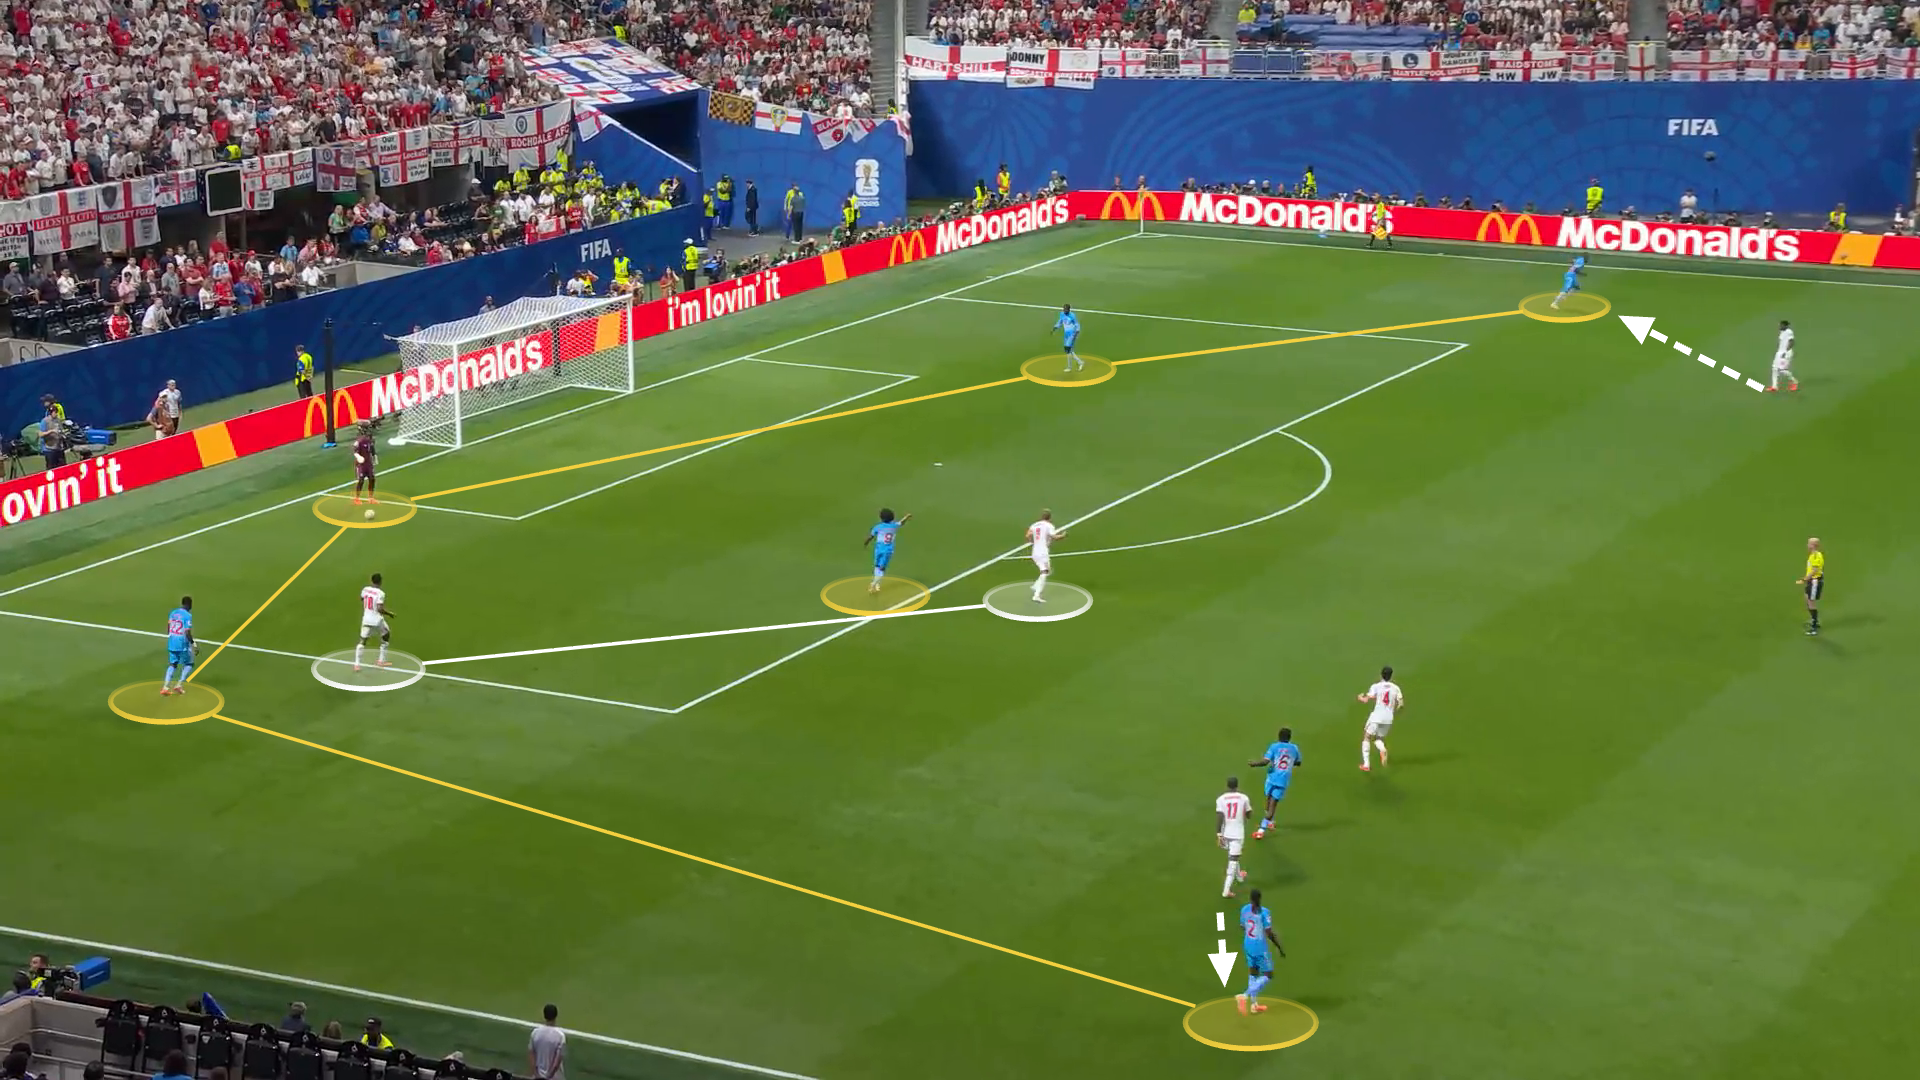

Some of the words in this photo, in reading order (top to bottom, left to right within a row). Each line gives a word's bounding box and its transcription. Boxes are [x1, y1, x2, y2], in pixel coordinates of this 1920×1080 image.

[911, 57, 996, 73] HARTSHILL
[1012, 51, 1045, 65] DONNY
[1495, 59, 1560, 69] MAIDSTONE
[1392, 69, 1447, 77] HARTLEPOOL
[1496, 72, 1516, 80] HW
[1538, 71, 1557, 80] JW
[510, 131, 552, 148] ROCHDALE
[555, 124, 570, 139] AFC
[1667, 118, 1720, 136] FIFA
[36, 213, 76, 230] LEICESTER
[935, 196, 1069, 255] McDonald's
[1556, 217, 1800, 262] McDonald's
[580, 238, 612, 262] FIFA
[668, 296, 701, 331] i'm
[705, 273, 762, 319] lovin'
[765, 270, 781, 303] it
[370, 337, 544, 417] McDonald's
[0, 463, 88, 525] ovin'
[96, 455, 124, 499] it
[1382, 690, 1390, 706] 4
[1277, 754, 1290, 770] 6
[1226, 802, 1238, 820] 11
[1247, 919, 1256, 938] 2
